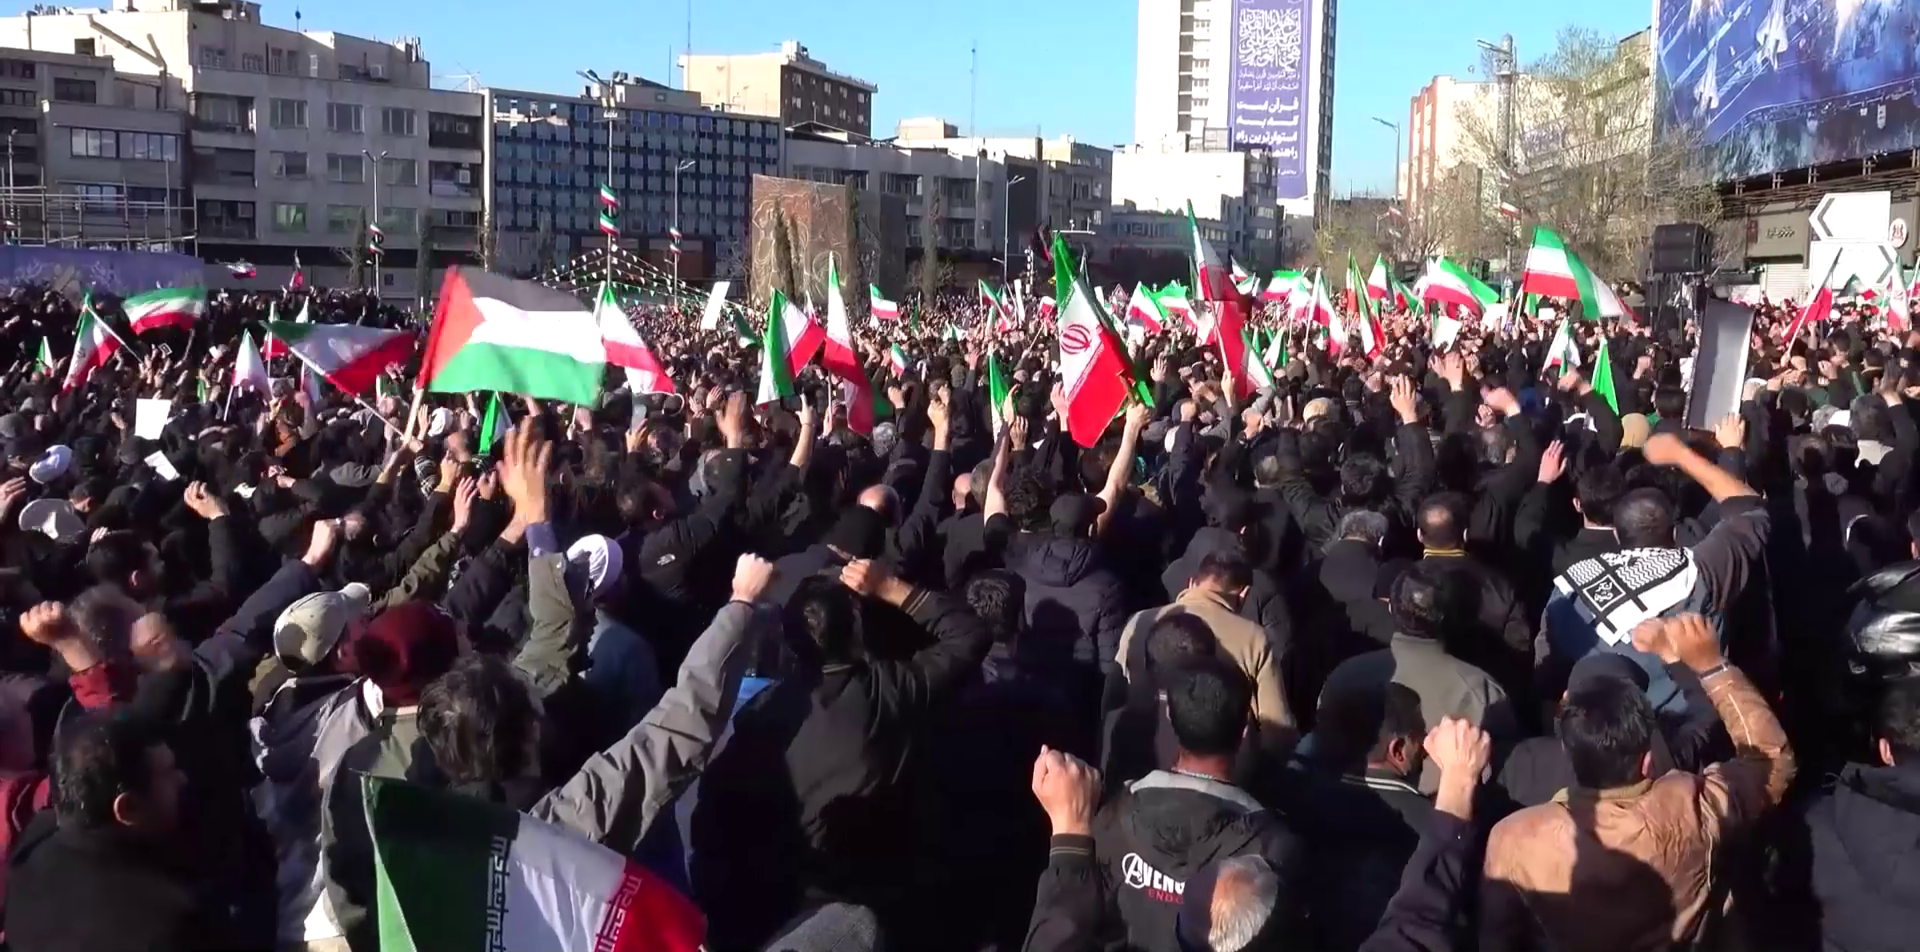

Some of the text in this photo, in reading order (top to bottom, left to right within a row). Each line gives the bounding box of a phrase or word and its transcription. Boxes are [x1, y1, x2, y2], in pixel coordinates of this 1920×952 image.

[1236, 115, 1299, 129] که به
[1236, 130, 1248, 144] راه
